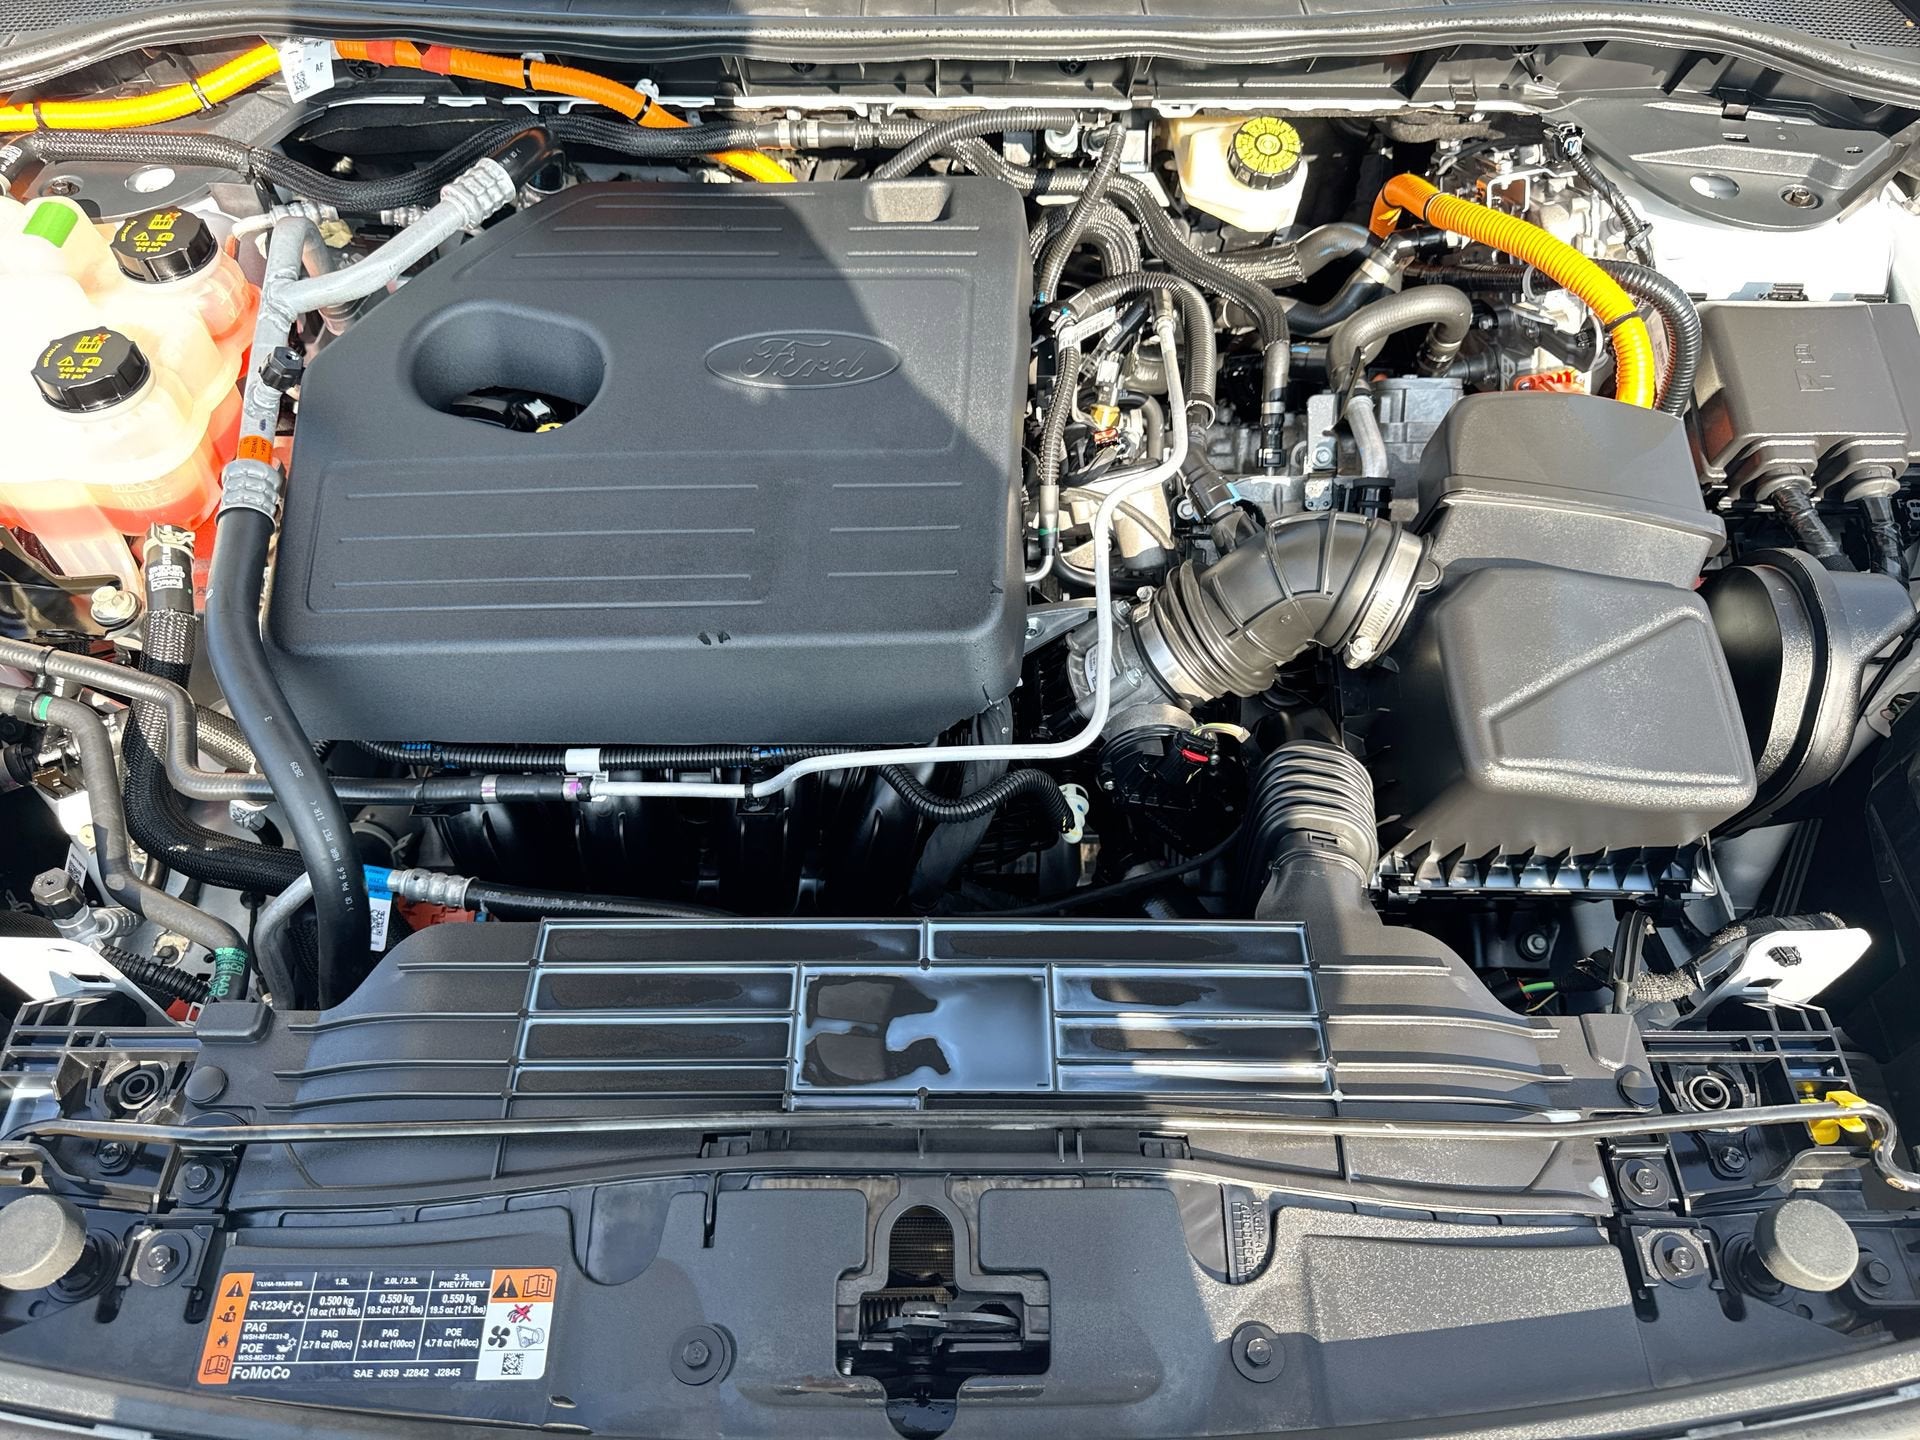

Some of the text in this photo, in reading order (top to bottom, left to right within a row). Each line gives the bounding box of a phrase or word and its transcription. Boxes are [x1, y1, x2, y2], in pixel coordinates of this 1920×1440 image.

[315, 62, 323, 72] AF
[739, 338, 866, 378] Ford
[335, 1277, 349, 1285] 1.5L
[384, 1277, 399, 1285] 2.0L
[320, 1296, 354, 1307] 0.500 kg
[379, 1293, 415, 1305] 0.550 kg
[441, 1293, 477, 1305] 0.550 kg
[250, 1300, 293, 1312] R-1234yf
[367, 1306, 381, 1314] 19.5
[430, 1306, 444, 1314] 19.5
[244, 1322, 267, 1333] PAG
[445, 1328, 462, 1336] POE
[321, 1330, 339, 1338] PAG
[382, 1329, 399, 1337] PAG
[302, 1341, 314, 1349] 2.7
[321, 1341, 330, 1349] oz
[361, 1340, 372, 1348] 3.4
[425, 1339, 436, 1347] 4.7
[240, 1343, 264, 1353] POE
[232, 1365, 290, 1379] FoMoCo
[353, 1367, 461, 1378] SAE J639 J2842 J2845
